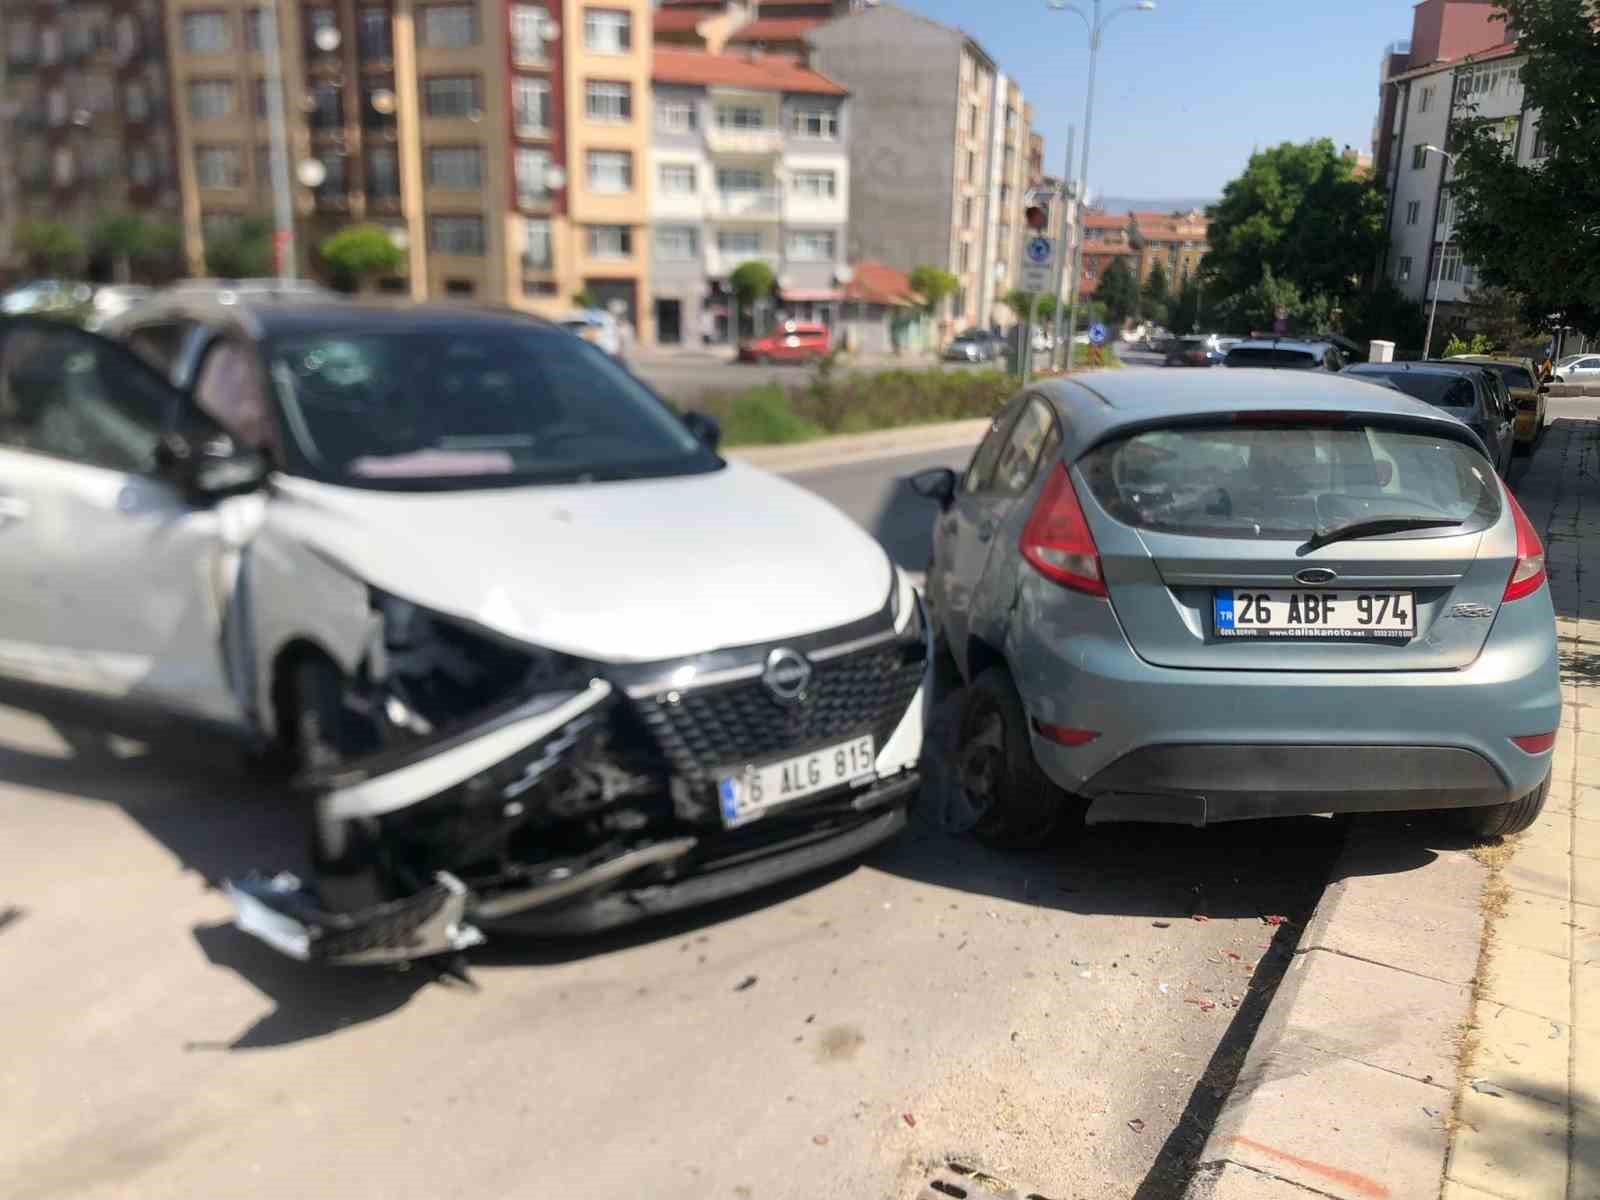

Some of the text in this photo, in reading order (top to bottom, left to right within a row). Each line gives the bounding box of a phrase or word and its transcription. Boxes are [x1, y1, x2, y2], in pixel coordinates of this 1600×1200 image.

[1220, 611, 1233, 620] TR
[1237, 594, 1408, 625] 26 ABF 974
[780, 756, 822, 794] ALG
[834, 741, 871, 777] 815
